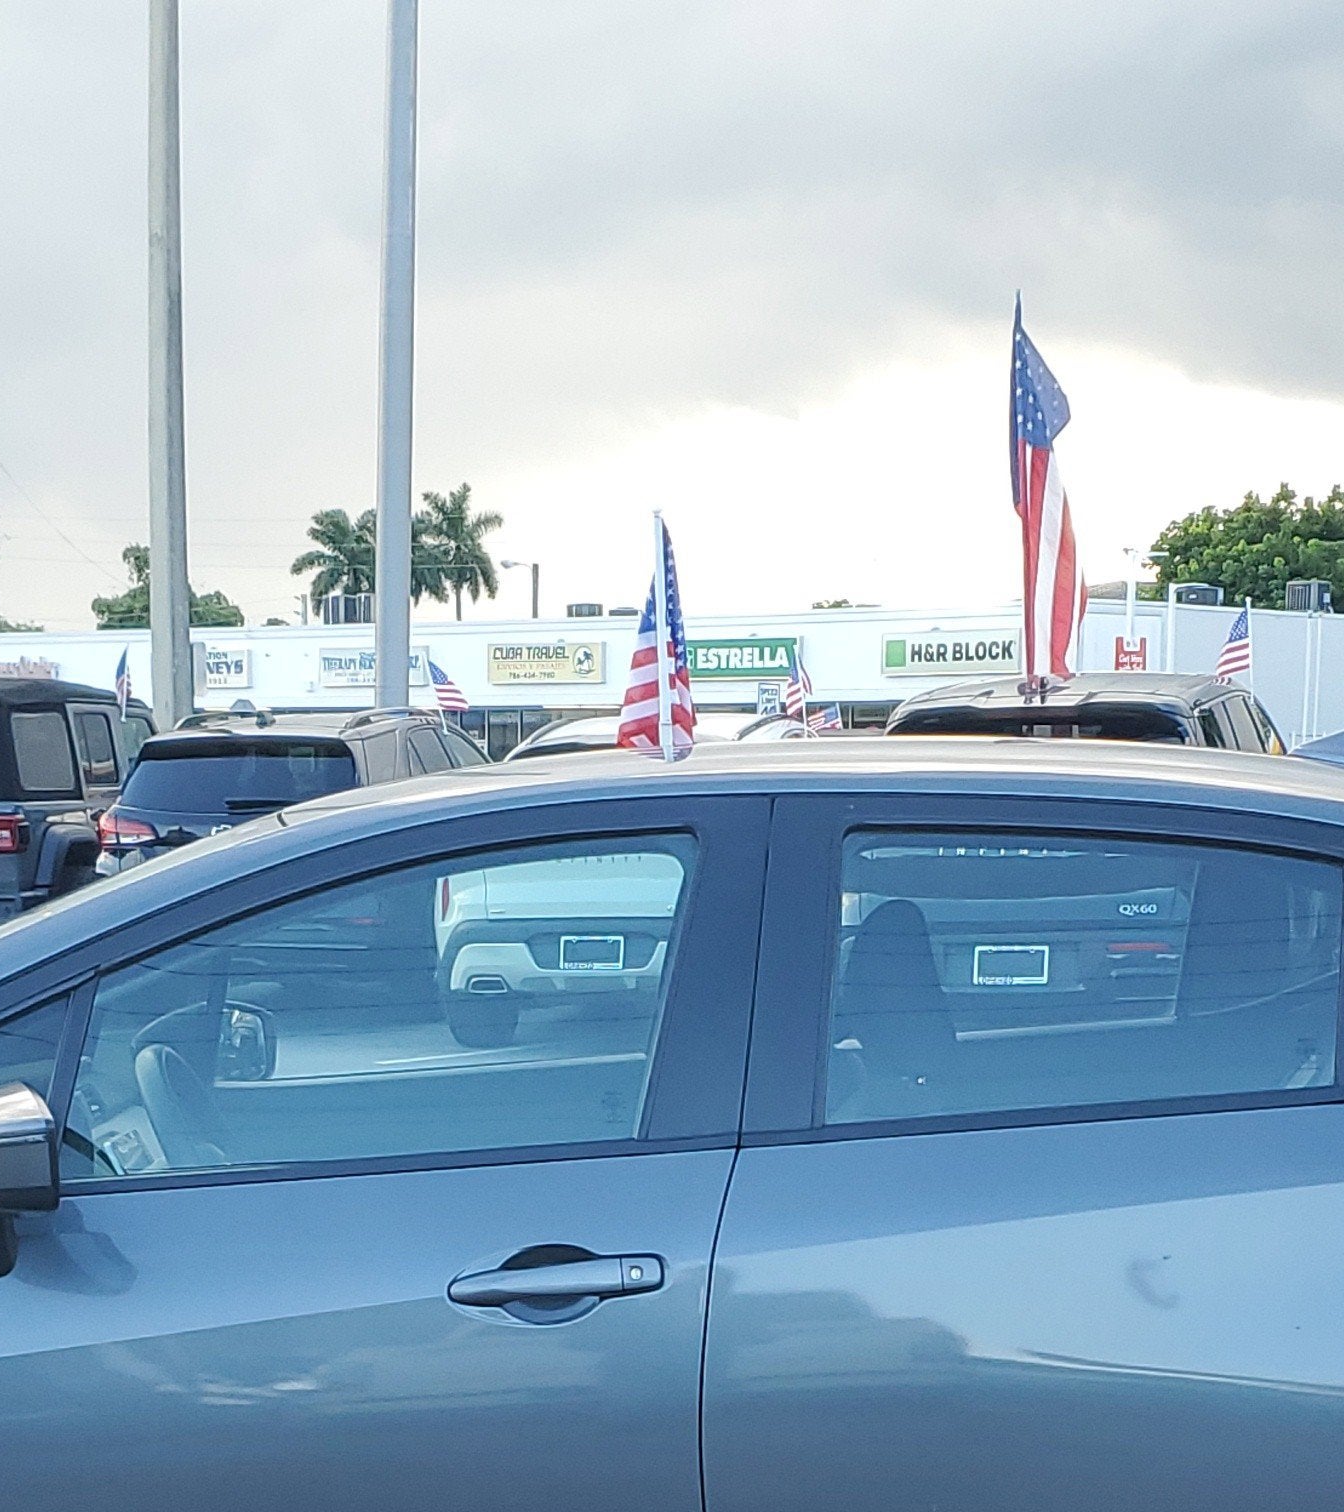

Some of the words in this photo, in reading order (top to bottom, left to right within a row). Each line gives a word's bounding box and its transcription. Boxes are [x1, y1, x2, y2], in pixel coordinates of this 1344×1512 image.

[493, 646, 523, 660] CUBA
[526, 645, 570, 660] TRAVEL
[697, 646, 790, 670] ESTRELLA
[910, 643, 948, 662] H&R
[952, 640, 1016, 661] BLOCK
[206, 659, 244, 675] VEYS
[1118, 903, 1158, 916] QX60
